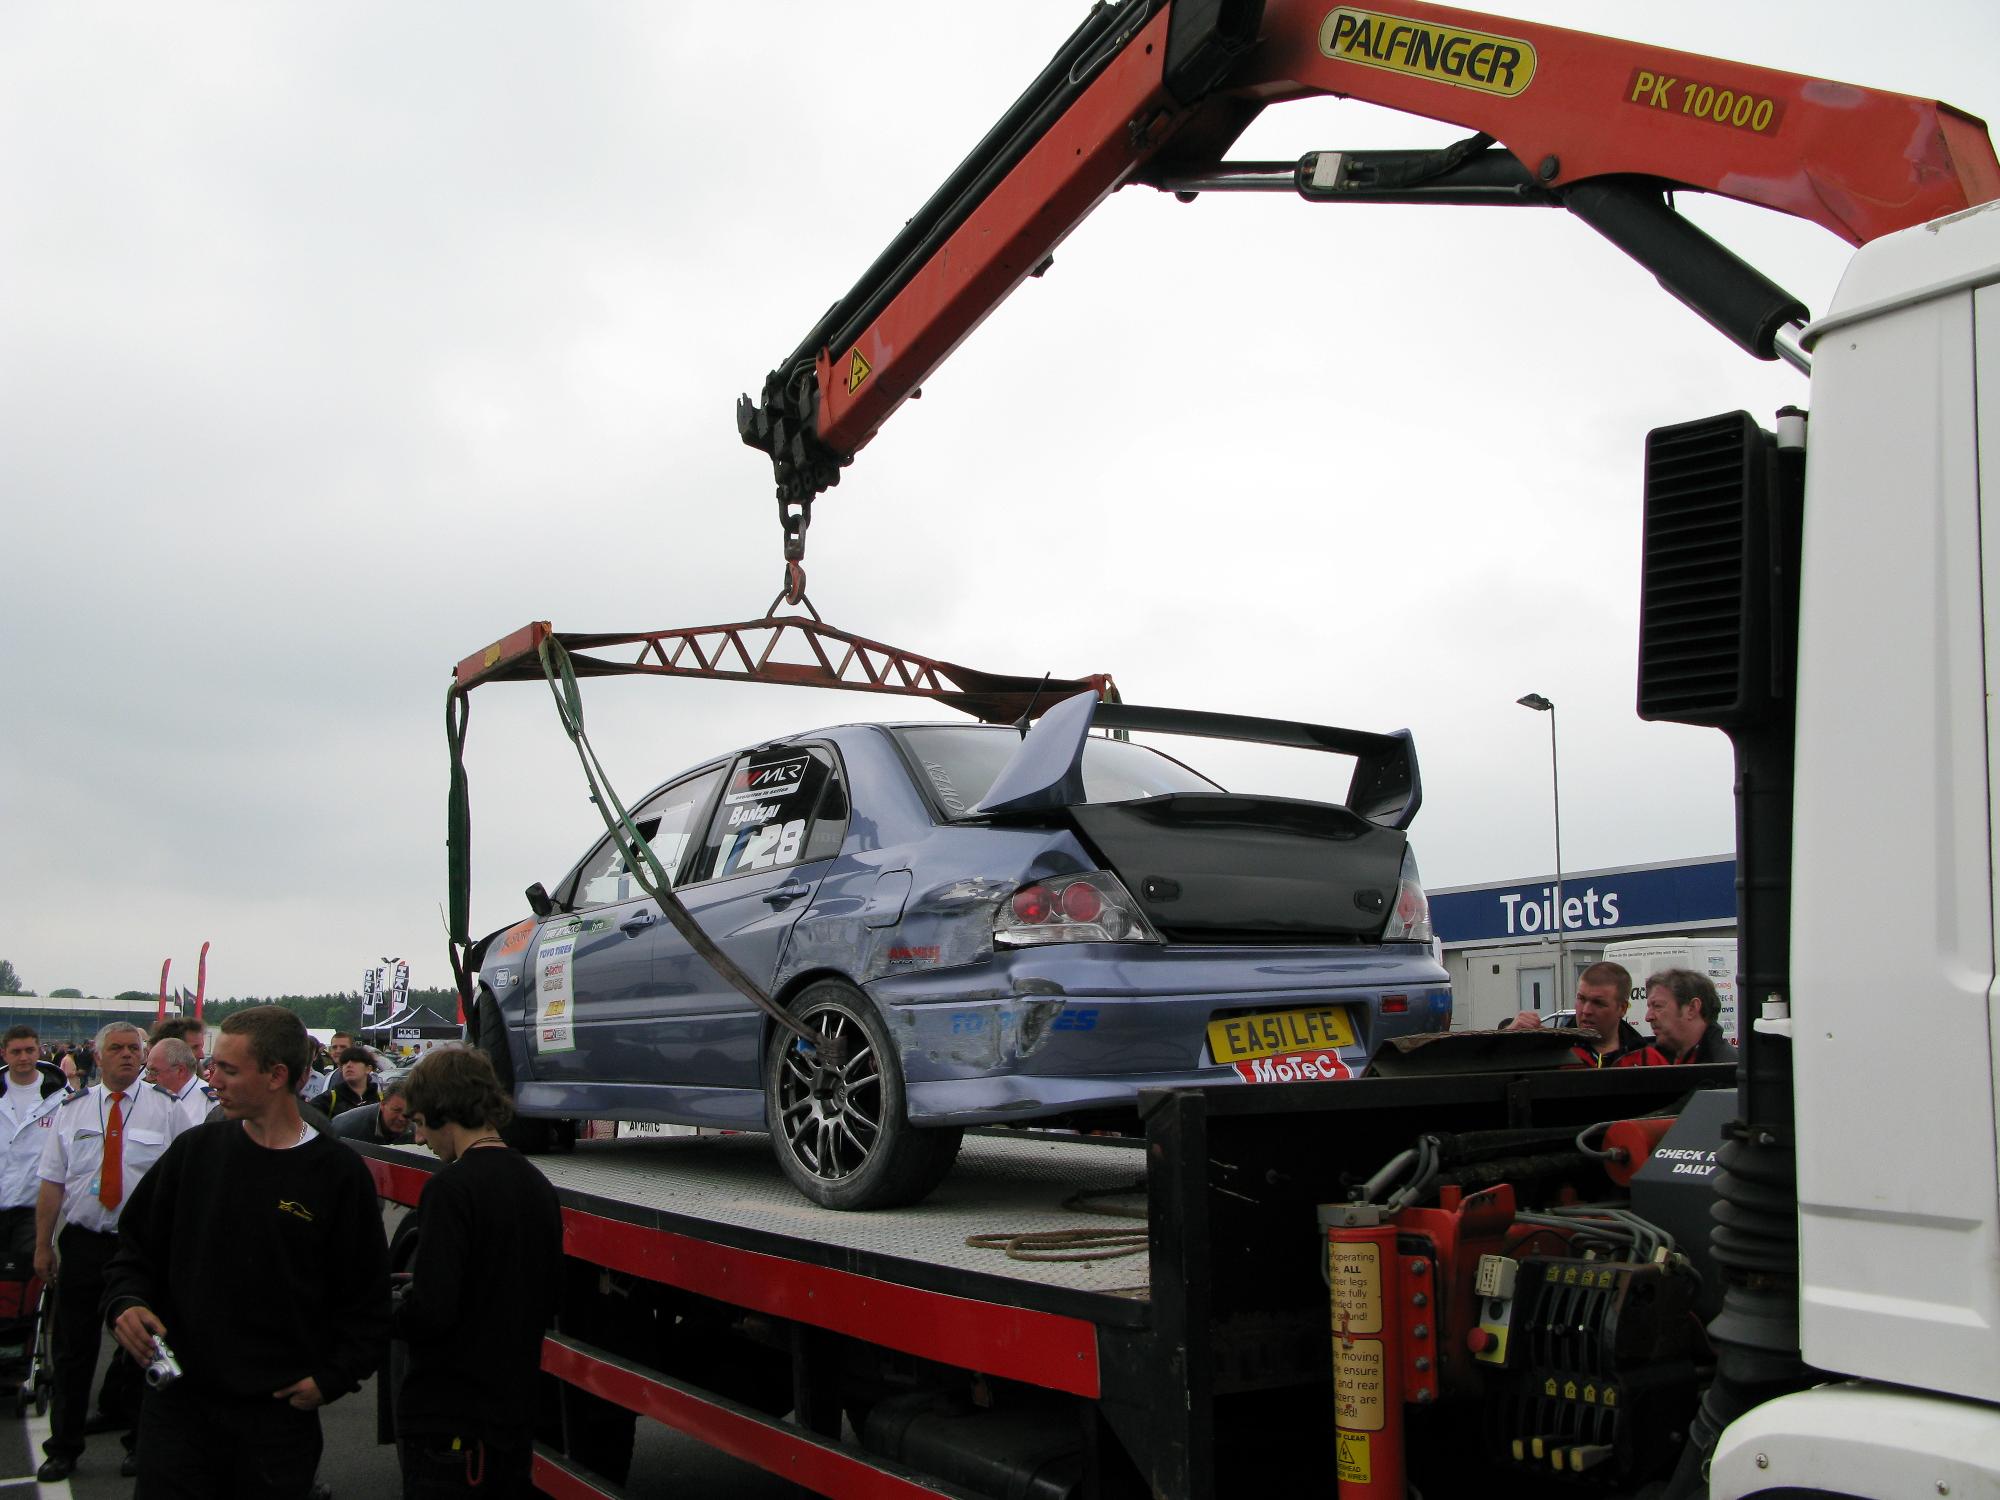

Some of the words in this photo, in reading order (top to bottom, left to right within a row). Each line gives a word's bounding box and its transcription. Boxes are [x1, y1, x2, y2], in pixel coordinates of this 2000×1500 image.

[1329, 14, 1521, 88] PALFINGER
[1631, 71, 1678, 110] PK
[1682, 83, 1774, 131] 10000
[752, 764, 802, 786] MLR
[1499, 887, 1619, 934] Toilets
[398, 1028, 420, 1037] HKS
[1251, 1055, 1336, 1083] MoTeC
[1654, 1149, 1705, 1160] CHECK
[1672, 1163, 1716, 1175] DAILY
[1344, 1265, 1361, 1273] ALL
[1349, 1277, 1367, 1287] legs
[1349, 1289, 1367, 1299] fully
[1341, 1352, 1379, 1364] moving
[1344, 1367, 1378, 1376] ensure
[1357, 1381, 1379, 1390] rear
[1360, 1396, 1377, 1404] are
